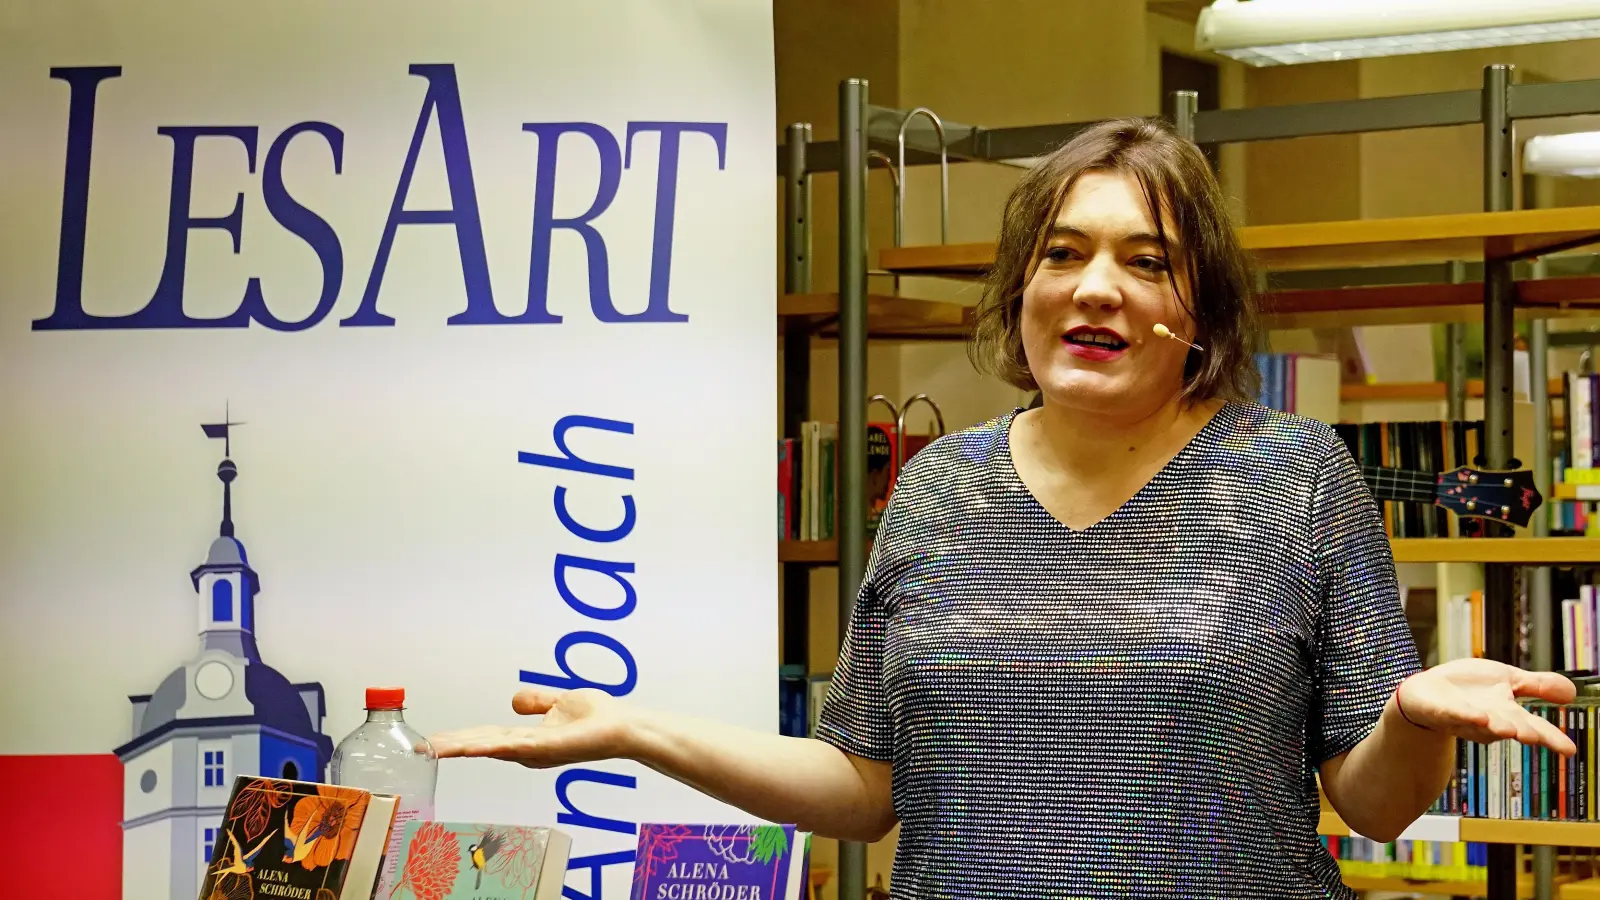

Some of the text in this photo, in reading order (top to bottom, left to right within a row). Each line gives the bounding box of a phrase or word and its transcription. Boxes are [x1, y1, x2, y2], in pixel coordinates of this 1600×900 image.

[518, 414, 638, 900] Anbach
[257, 868, 289, 883] ALENA
[666, 862, 730, 880] ALENA
[259, 882, 312, 900] SCHRÖDER
[656, 881, 761, 900] SCHRÖDER
